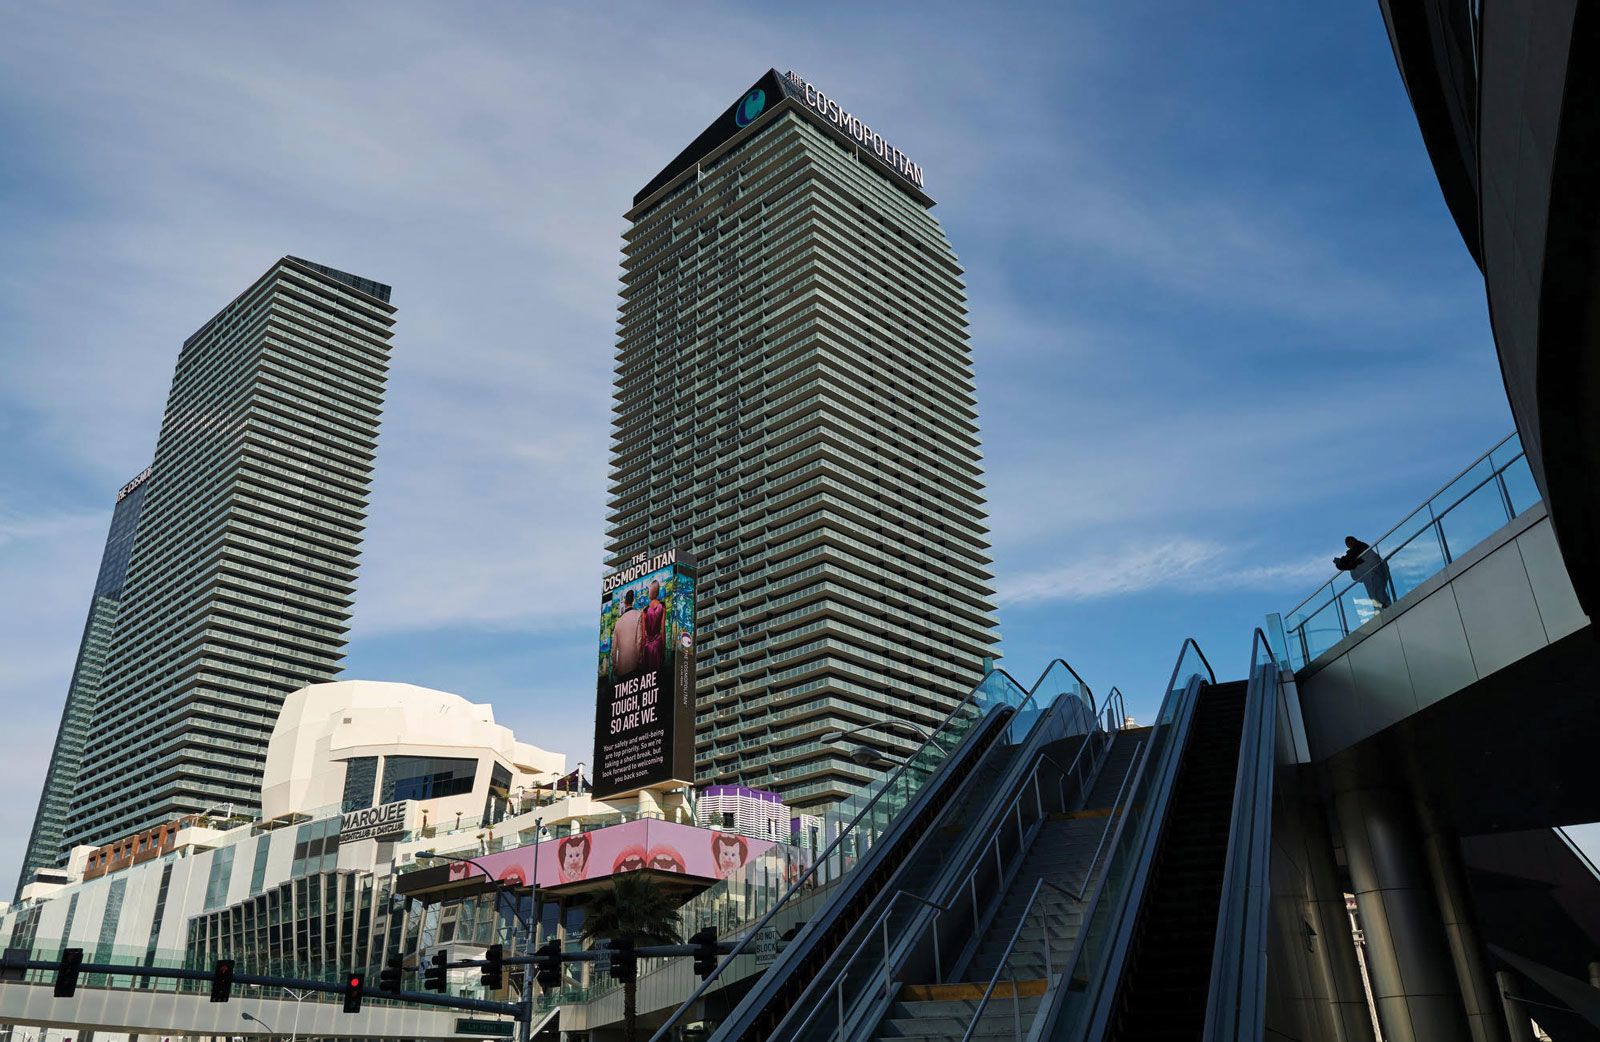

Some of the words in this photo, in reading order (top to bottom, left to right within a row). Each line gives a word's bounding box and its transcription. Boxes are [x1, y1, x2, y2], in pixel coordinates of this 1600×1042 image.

[804, 83, 924, 188] COSMOPOLITAN
[632, 551, 647, 565] THE
[603, 548, 676, 592] COSMOPOLITAN
[615, 678, 639, 699] TIMES
[640, 671, 657, 690] ARE
[611, 695, 640, 717] TOUGH,
[642, 688, 659, 707] BUT
[611, 718, 621, 734] SO
[623, 712, 640, 731] ARE
[641, 706, 658, 725] WE.
[604, 744, 614, 752] Your
[615, 740, 628, 749] safety
[629, 736, 638, 744] and
[639, 730, 664, 741] well-being
[622, 745, 640, 756] priority.
[648, 739, 661, 747] we're
[605, 760, 619, 768] taking
[624, 754, 636, 763] short
[613, 764, 631, 774] forward
[638, 756, 663, 767] welcoming
[615, 776, 623, 784] you
[624, 772, 635, 780] back
[341, 802, 406, 830] MARQUEE
[340, 828, 371, 841] NIGHTCLUB
[371, 828, 377, 836] &
[377, 822, 404, 835] DAYCLUB
[764, 931, 776, 940] NOT
